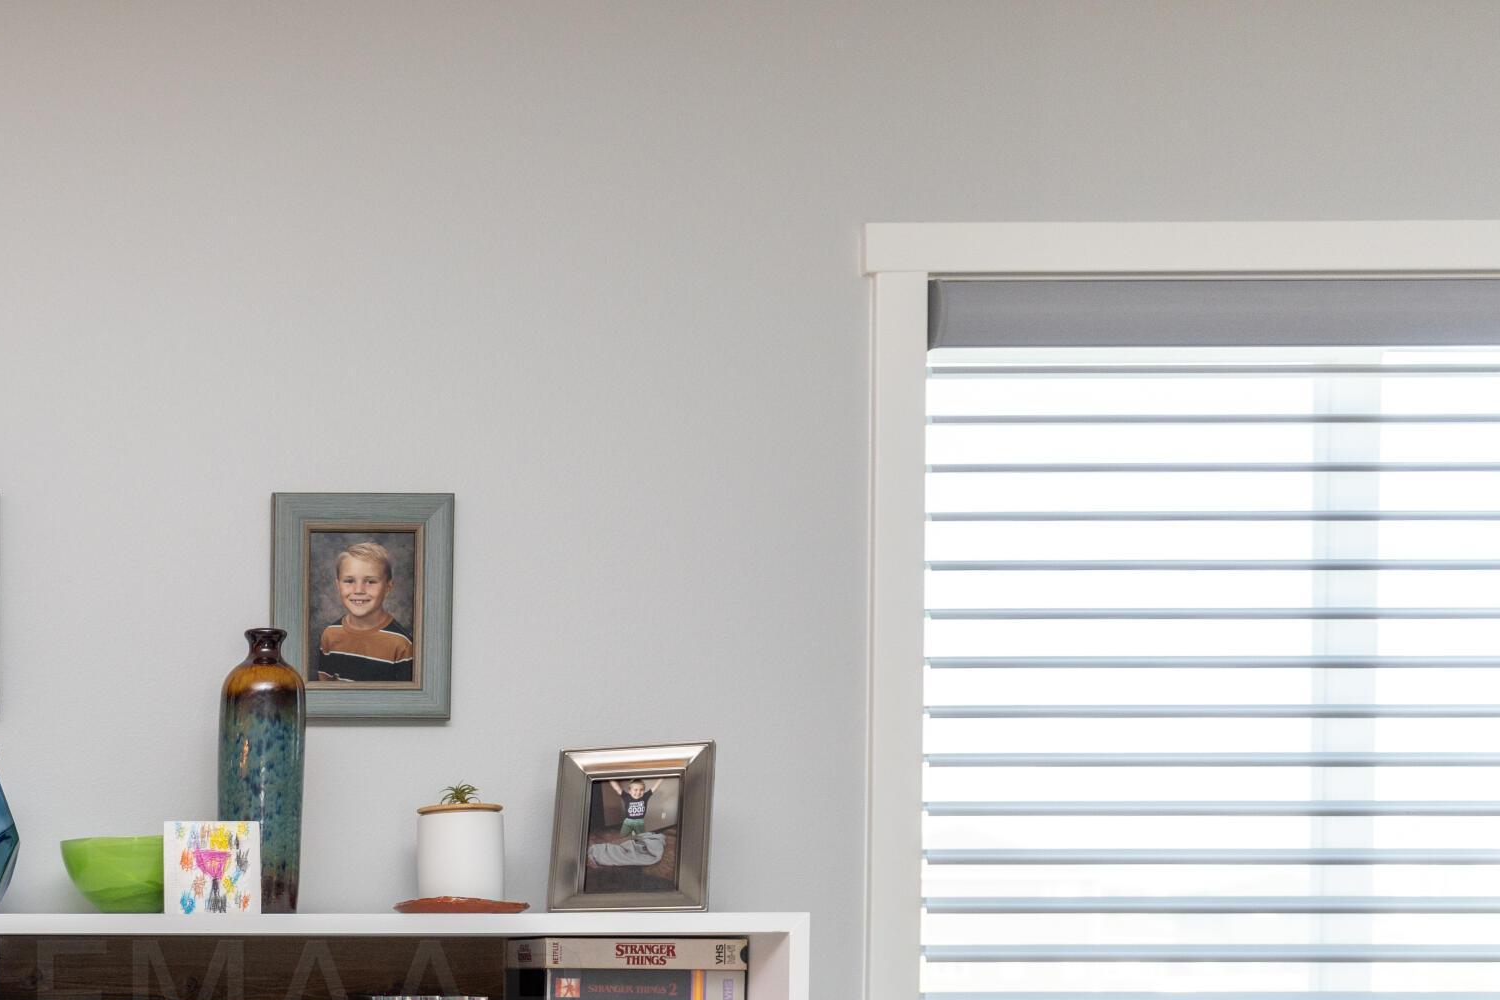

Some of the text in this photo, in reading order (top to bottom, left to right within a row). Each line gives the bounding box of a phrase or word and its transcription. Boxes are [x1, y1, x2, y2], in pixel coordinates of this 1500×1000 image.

[615, 943, 676, 957] STRANGER
[626, 956, 666, 965] THINGS
[669, 983, 676, 995] 2
